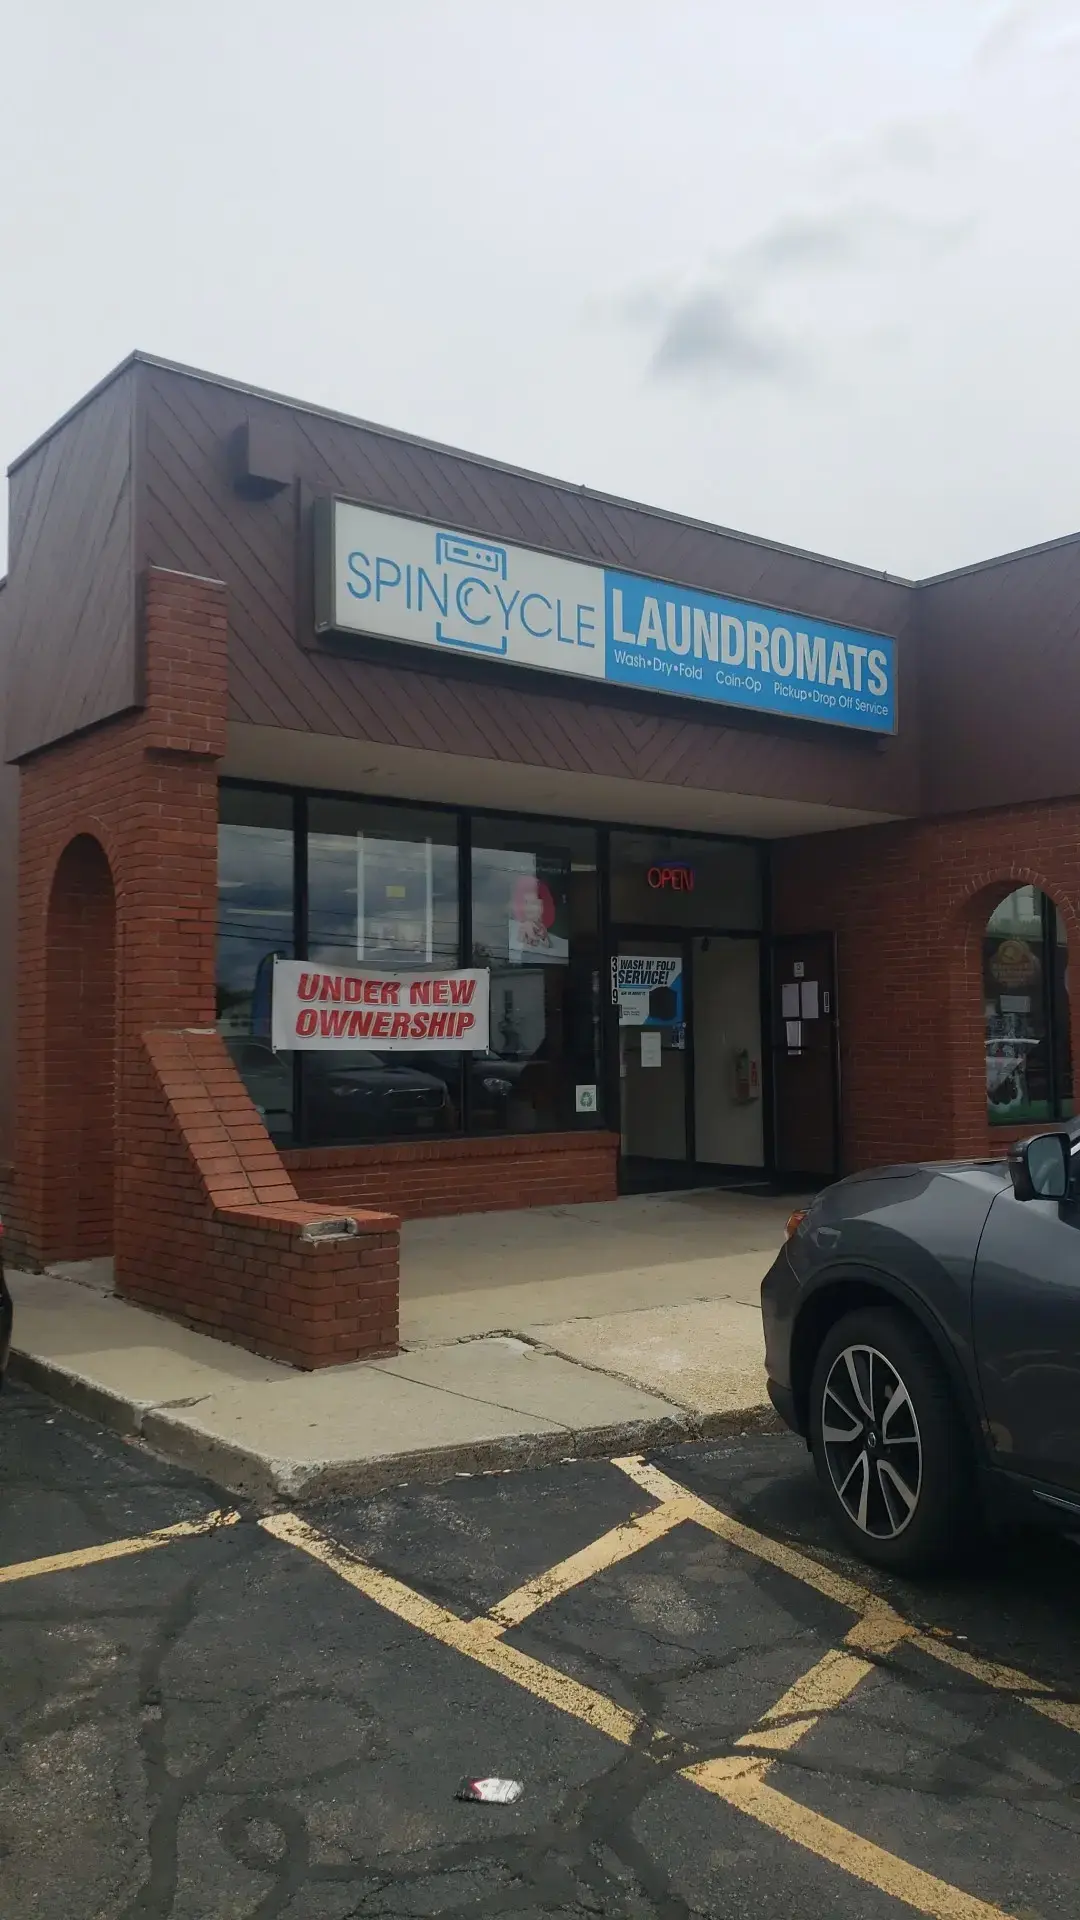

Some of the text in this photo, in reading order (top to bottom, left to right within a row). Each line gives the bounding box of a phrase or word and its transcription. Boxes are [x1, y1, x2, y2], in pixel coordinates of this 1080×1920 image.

[612, 588, 888, 697] LAUNDROMATS
[716, 670, 762, 693] Coin-Op
[838, 695, 853, 709] Off
[855, 698, 888, 716] Service
[647, 867, 694, 892] OPEN
[618, 970, 669, 985] SERVICE!
[620, 959, 644, 970] WASH
[656, 961, 676, 971] FOLD
[297, 973, 477, 1006] UNDER NEW
[295, 1008, 476, 1039] OWNERSHIP
